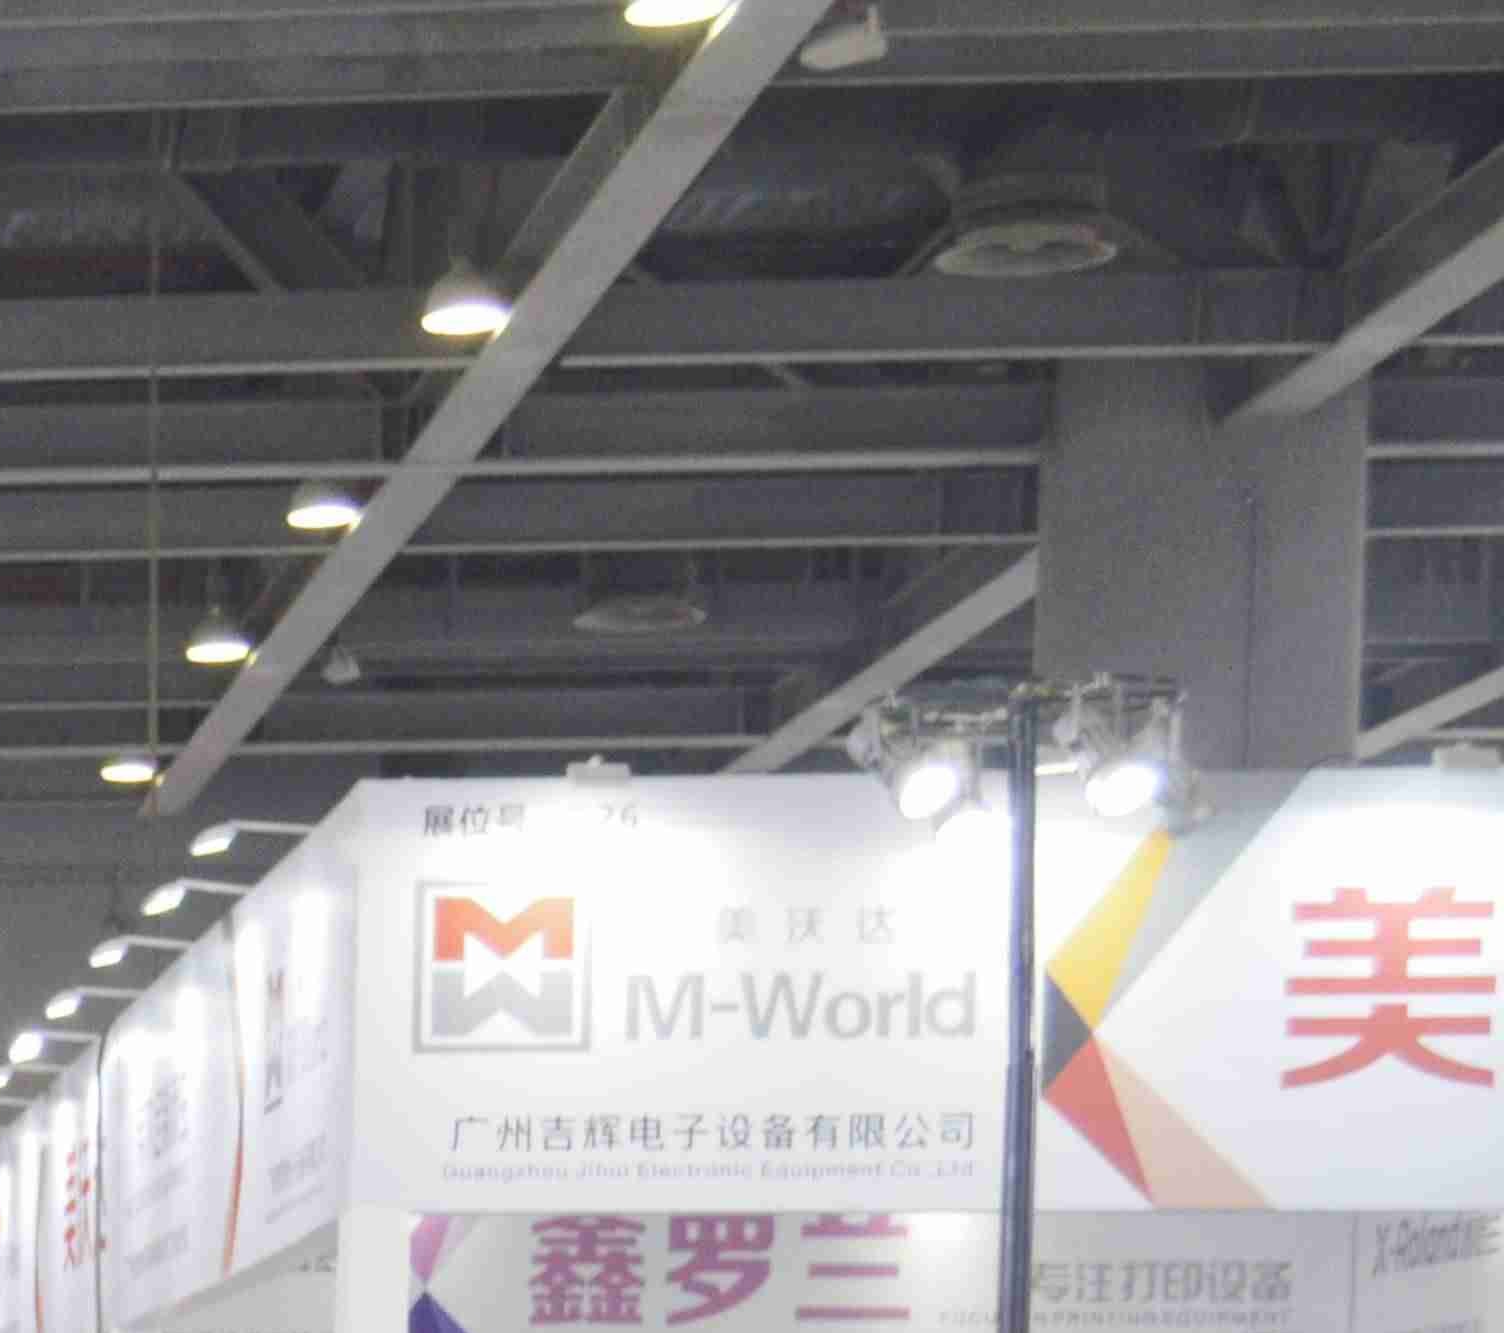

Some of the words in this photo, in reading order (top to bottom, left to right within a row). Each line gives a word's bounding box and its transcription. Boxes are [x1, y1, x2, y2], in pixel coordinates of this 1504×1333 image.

[625, 971, 977, 1040] M-World
[1281, 885, 1497, 1089] 美
[449, 1113, 975, 1151] 广州吉辉电子设备有限公司
